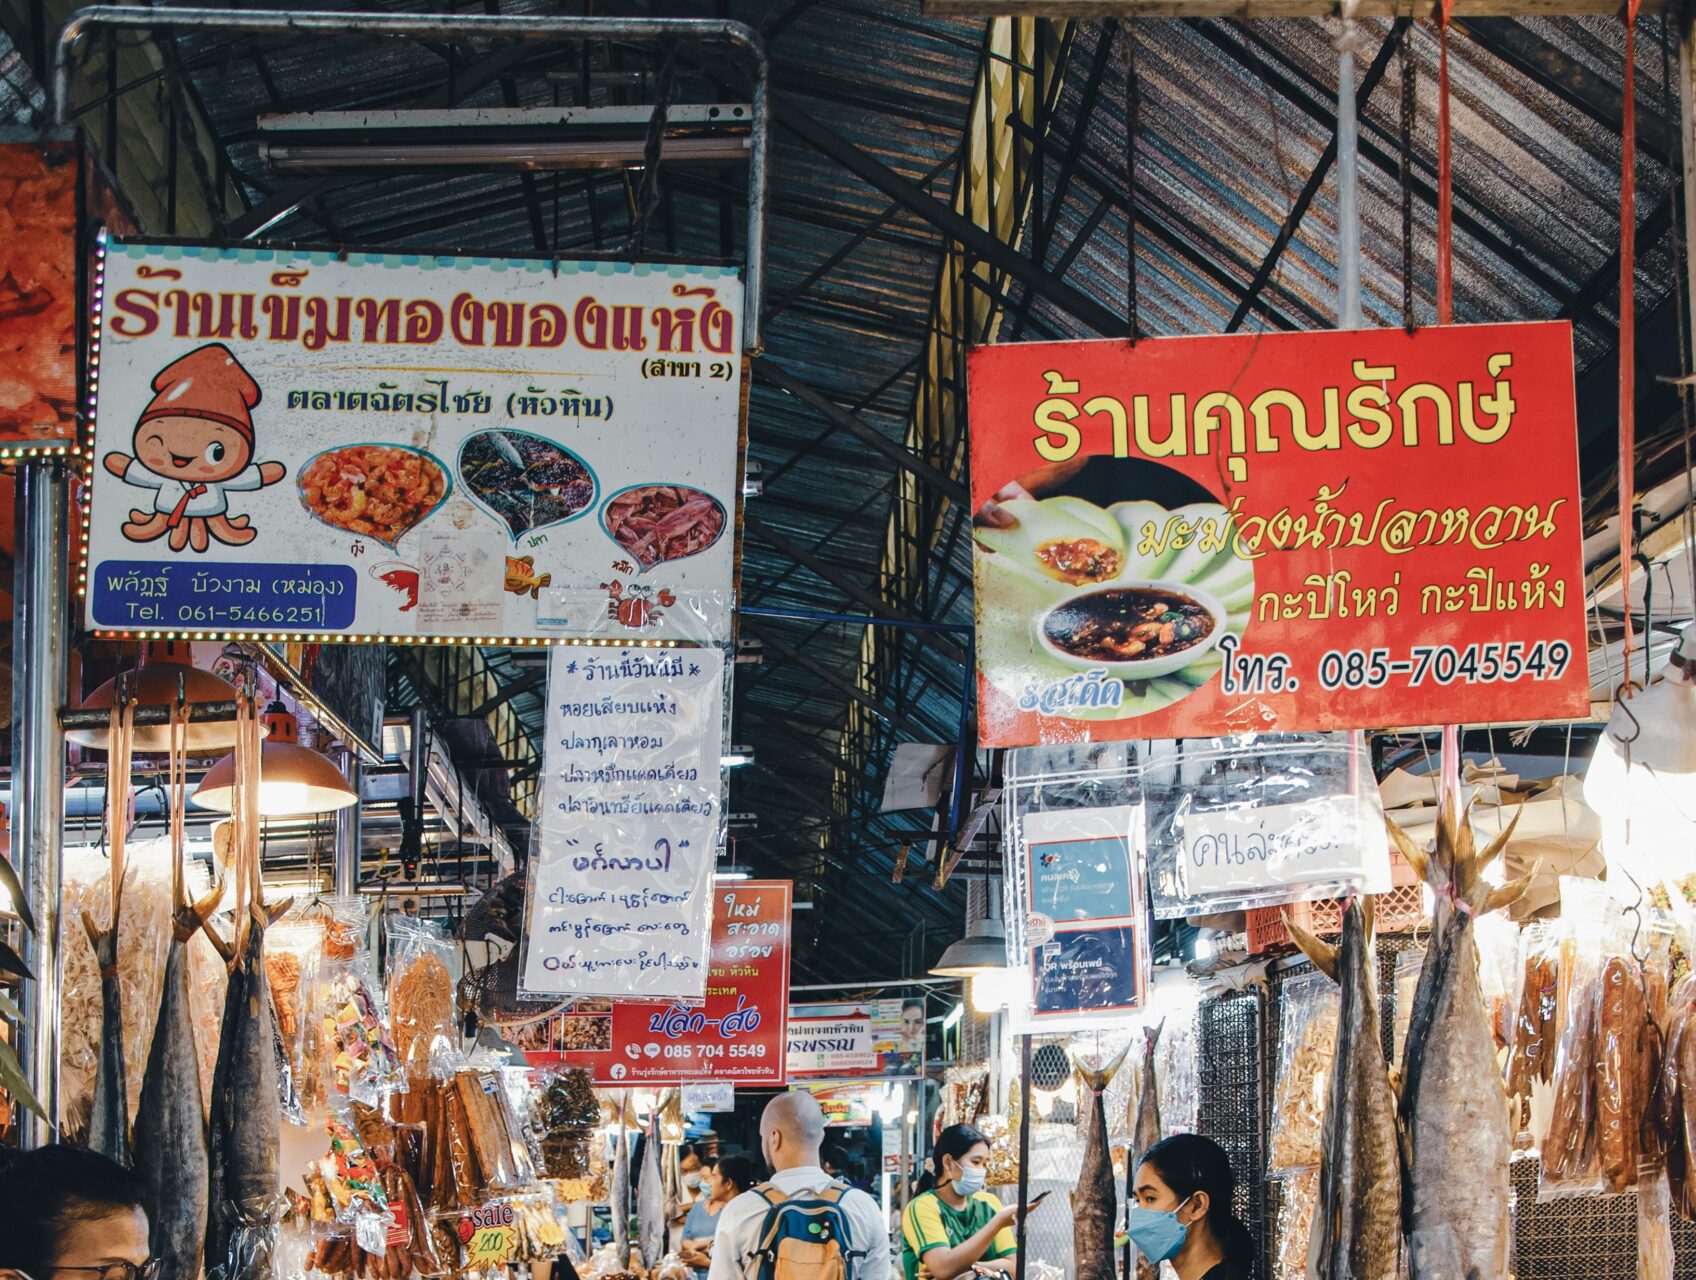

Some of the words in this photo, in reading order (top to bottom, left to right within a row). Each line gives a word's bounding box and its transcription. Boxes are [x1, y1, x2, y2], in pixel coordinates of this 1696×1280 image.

[109, 265, 734, 354] ร้านเข็มทองของแห้ง
[641, 358, 703, 380] (สาขา
[708, 360, 734, 381] 2)
[287, 379, 492, 416] ตลาดฉัตรไชย
[506, 387, 615, 421] (หัวหิน)
[1033, 354, 1516, 481] ร้านคุณรักษ์
[1136, 477, 1567, 560] มะม่วงน้ำปลาหวาน
[527, 533, 549, 548] ปลา
[193, 569, 261, 596] บัวงาม
[271, 571, 344, 598] (หม่อง)
[126, 602, 165, 621] Tel.
[179, 604, 324, 625] 061-5466251
[1217, 634, 1299, 695] โทร.
[1319, 641, 1570, 692] 085-7045549
[724, 893, 761, 918] ใหม่
[727, 922, 779, 936] สะอาด
[726, 938, 772, 958] อร่อย
[730, 965, 759, 977] หัวหิน
[664, 1045, 692, 1058] 085
[696, 1045, 724, 1058] 704
[729, 1044, 766, 1058] 5549
[473, 1205, 513, 1227] sale
[479, 1232, 503, 1251] 200
